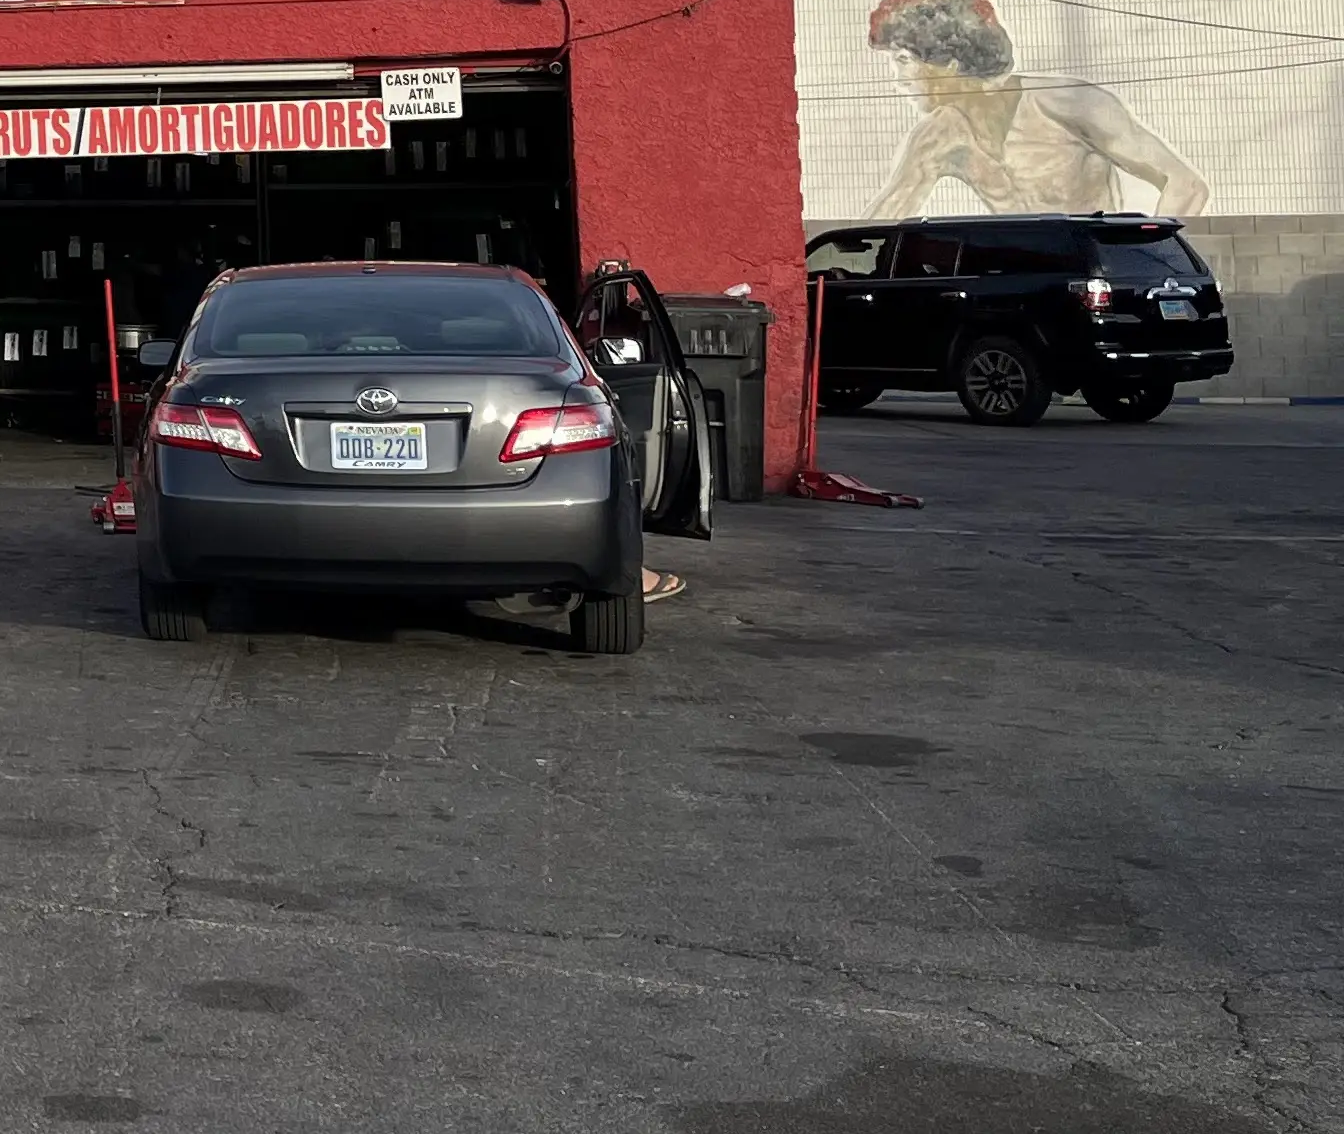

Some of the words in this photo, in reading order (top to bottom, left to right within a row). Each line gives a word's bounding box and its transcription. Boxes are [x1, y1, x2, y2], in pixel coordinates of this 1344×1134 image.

[386, 73, 419, 86] CASH
[423, 72, 456, 84] ONLY
[409, 88, 434, 100] ATM
[389, 102, 456, 116] AVAILABLE
[355, 426, 400, 435] NEVADA
